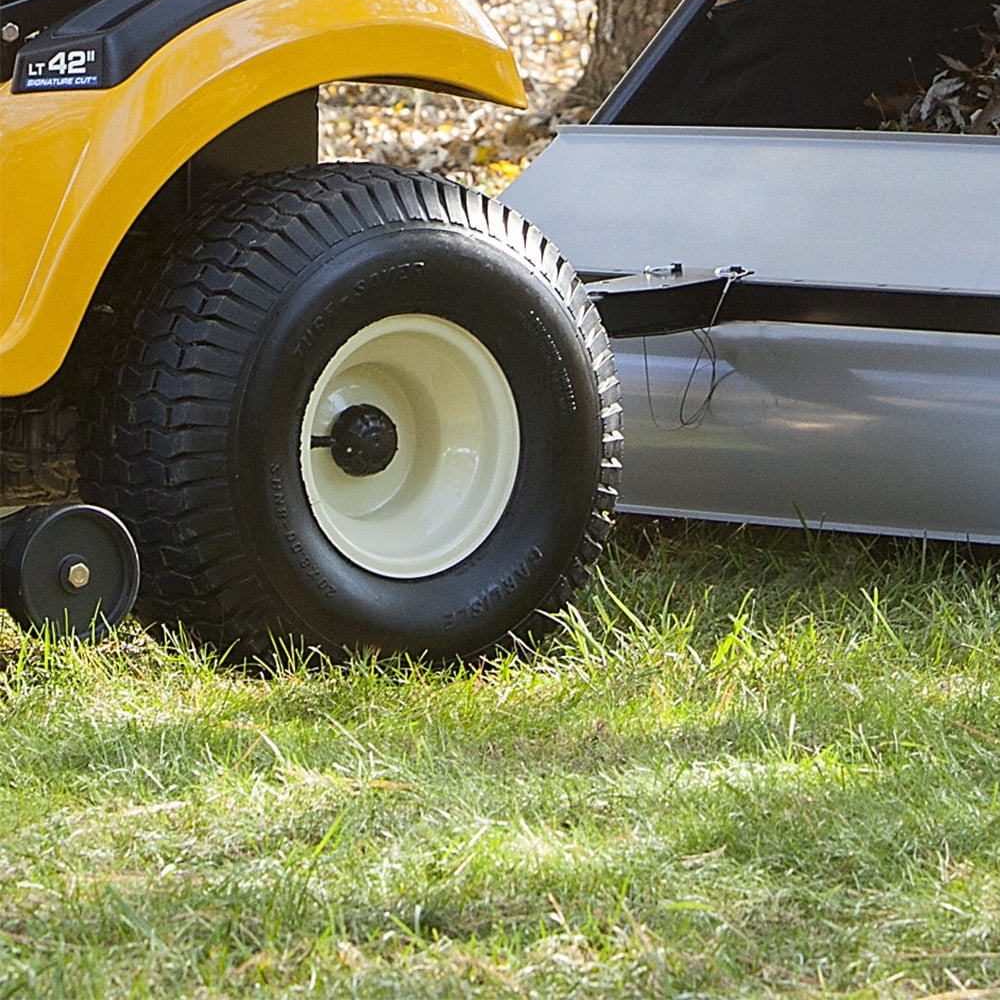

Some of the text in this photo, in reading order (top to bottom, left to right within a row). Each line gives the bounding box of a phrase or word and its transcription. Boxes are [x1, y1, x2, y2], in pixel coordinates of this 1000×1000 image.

[28, 50, 95, 76] LT 42"
[26, 77, 73, 88] SIGNATURE
